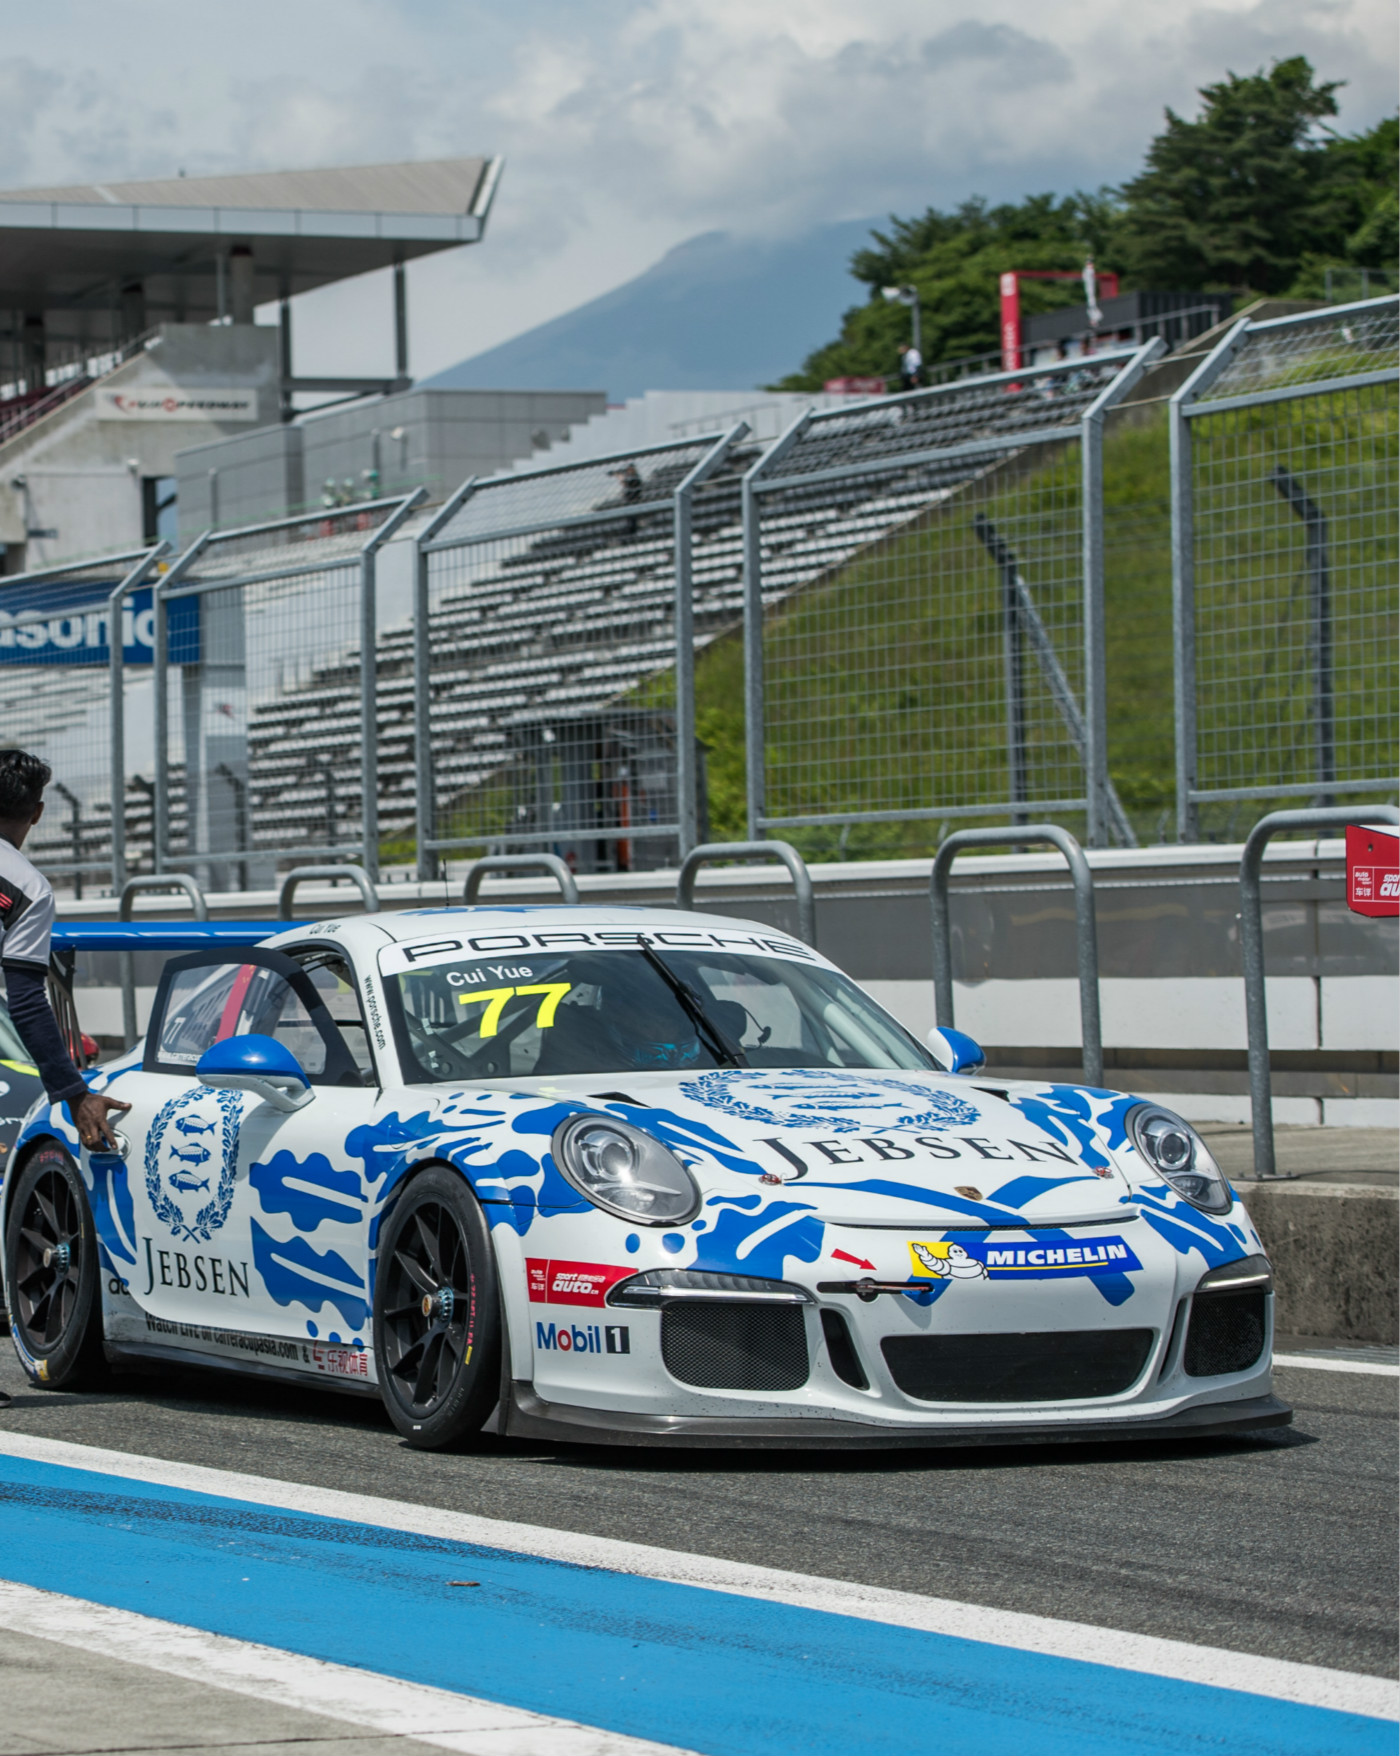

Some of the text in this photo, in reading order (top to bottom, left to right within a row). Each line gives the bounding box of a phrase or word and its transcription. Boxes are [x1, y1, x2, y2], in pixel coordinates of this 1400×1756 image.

[402, 932, 817, 963] PORSCHE
[447, 962, 533, 987] Cui Yue
[364, 975, 386, 1050] www.porsche.com
[459, 983, 571, 1039] 77
[753, 1136, 1079, 1181] JEBSEN
[142, 1237, 250, 1299] JEBSEN
[987, 1242, 1128, 1266] MICHELIN
[536, 1321, 602, 1354] Mobil
